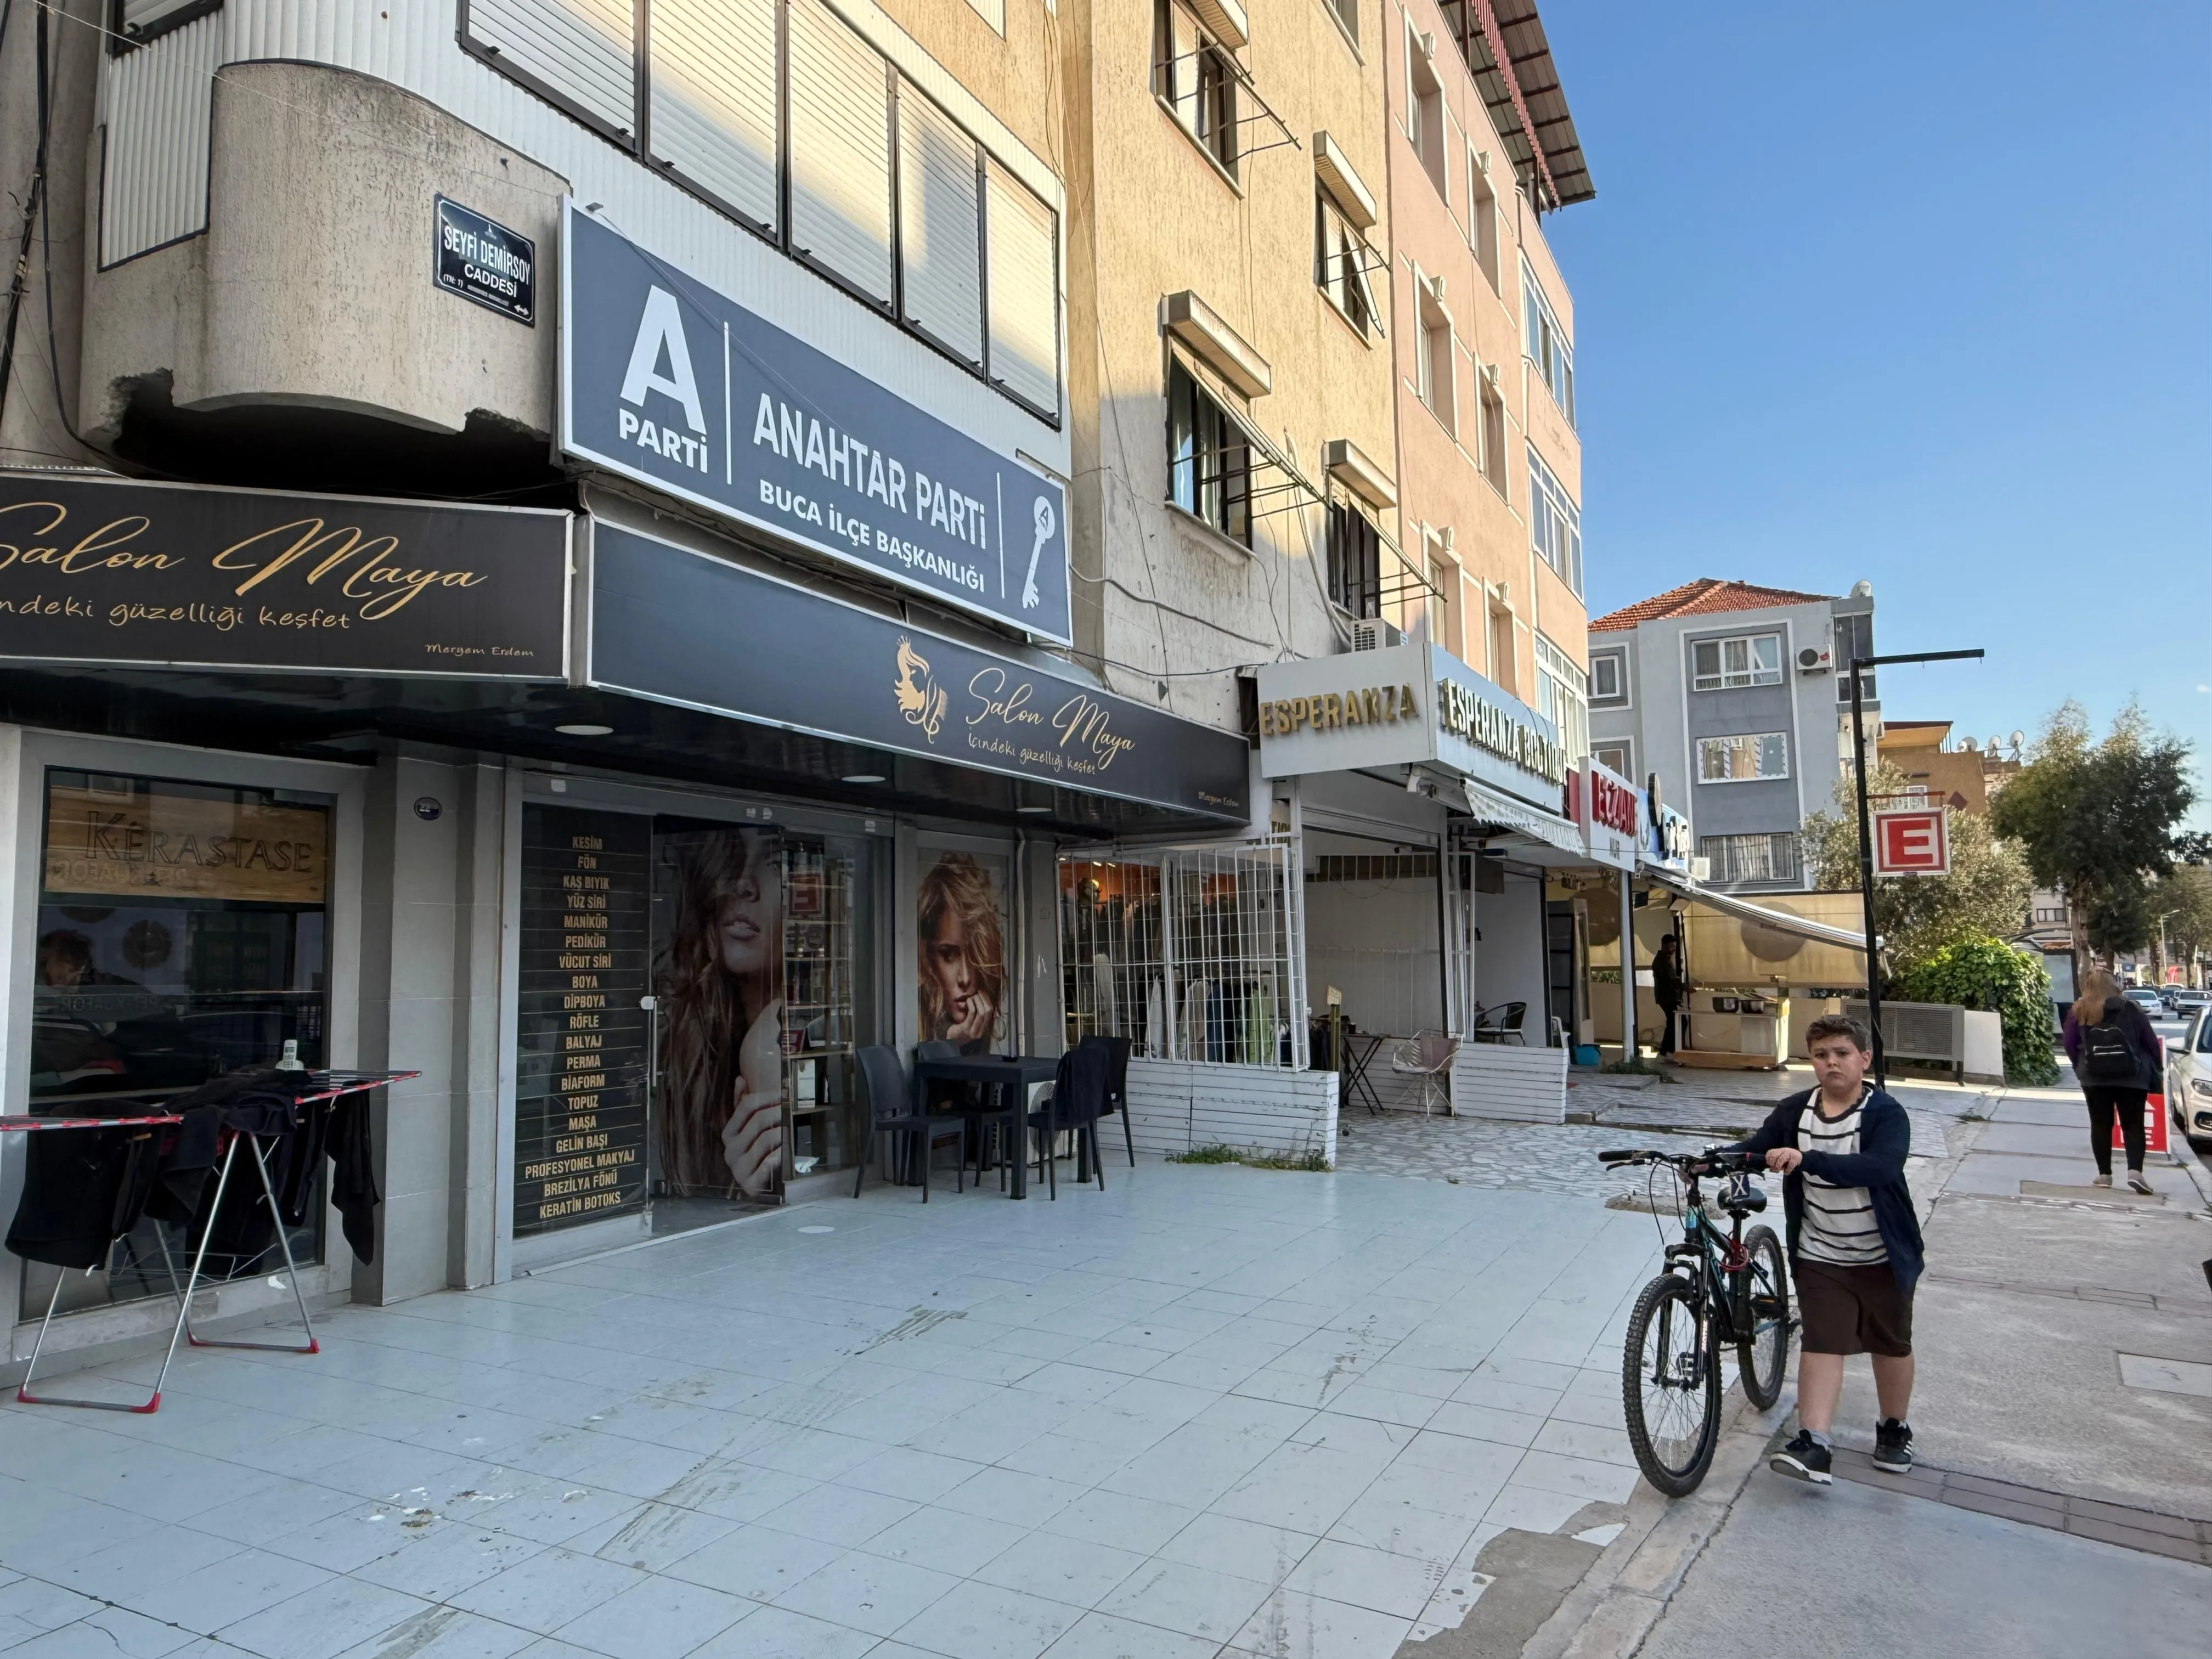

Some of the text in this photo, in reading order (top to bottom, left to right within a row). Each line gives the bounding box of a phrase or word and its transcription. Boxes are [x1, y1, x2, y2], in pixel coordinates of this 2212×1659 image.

[444, 225, 531, 285] SEYFİ DEMİRSOY
[464, 264, 517, 298] CADDESİ
[620, 284, 707, 435] A
[619, 408, 708, 473] PARTİ
[753, 393, 986, 549] ANAHTAR PARTİ
[760, 479, 985, 593] BUCA İLÇE BAŞKANLIĞI
[0, 502, 488, 621] Salon Maya
[109, 599, 244, 631] güzelliği
[259, 605, 350, 629] keşfet
[492, 647, 534, 656] Erdem
[966, 667, 1136, 770] Salon Maya
[1260, 683, 1419, 736] ESPERANZA
[1442, 678, 1521, 762] ESPERANZA
[1020, 748, 1063, 772] güzelliği
[1592, 770, 1637, 839] ECZAN
[1888, 820, 1933, 865] E
[563, 875, 582, 890] KAŞ
[567, 893, 585, 909] YÜZ
[564, 913, 608, 929] MANİKÜR
[566, 933, 606, 948] PEDİKÜR
[559, 953, 590, 968] VÜCUT
[573, 976, 597, 988] BOYA
[570, 1013, 599, 1029] RÖFLE
[566, 1035, 602, 1049] BALYAJ
[567, 1055, 600, 1069] PERMA
[568, 1095, 598, 1110] TOPUZ
[568, 1115, 596, 1132] MAŞA
[556, 1133, 608, 1153] GELİN BAŞI
[525, 1149, 634, 1178] PROFESYONEL MAKYAJ
[544, 1169, 617, 1197] BREZİLYA FÖNÜ
[540, 1191, 621, 1219] KERATİN BOTOKS
